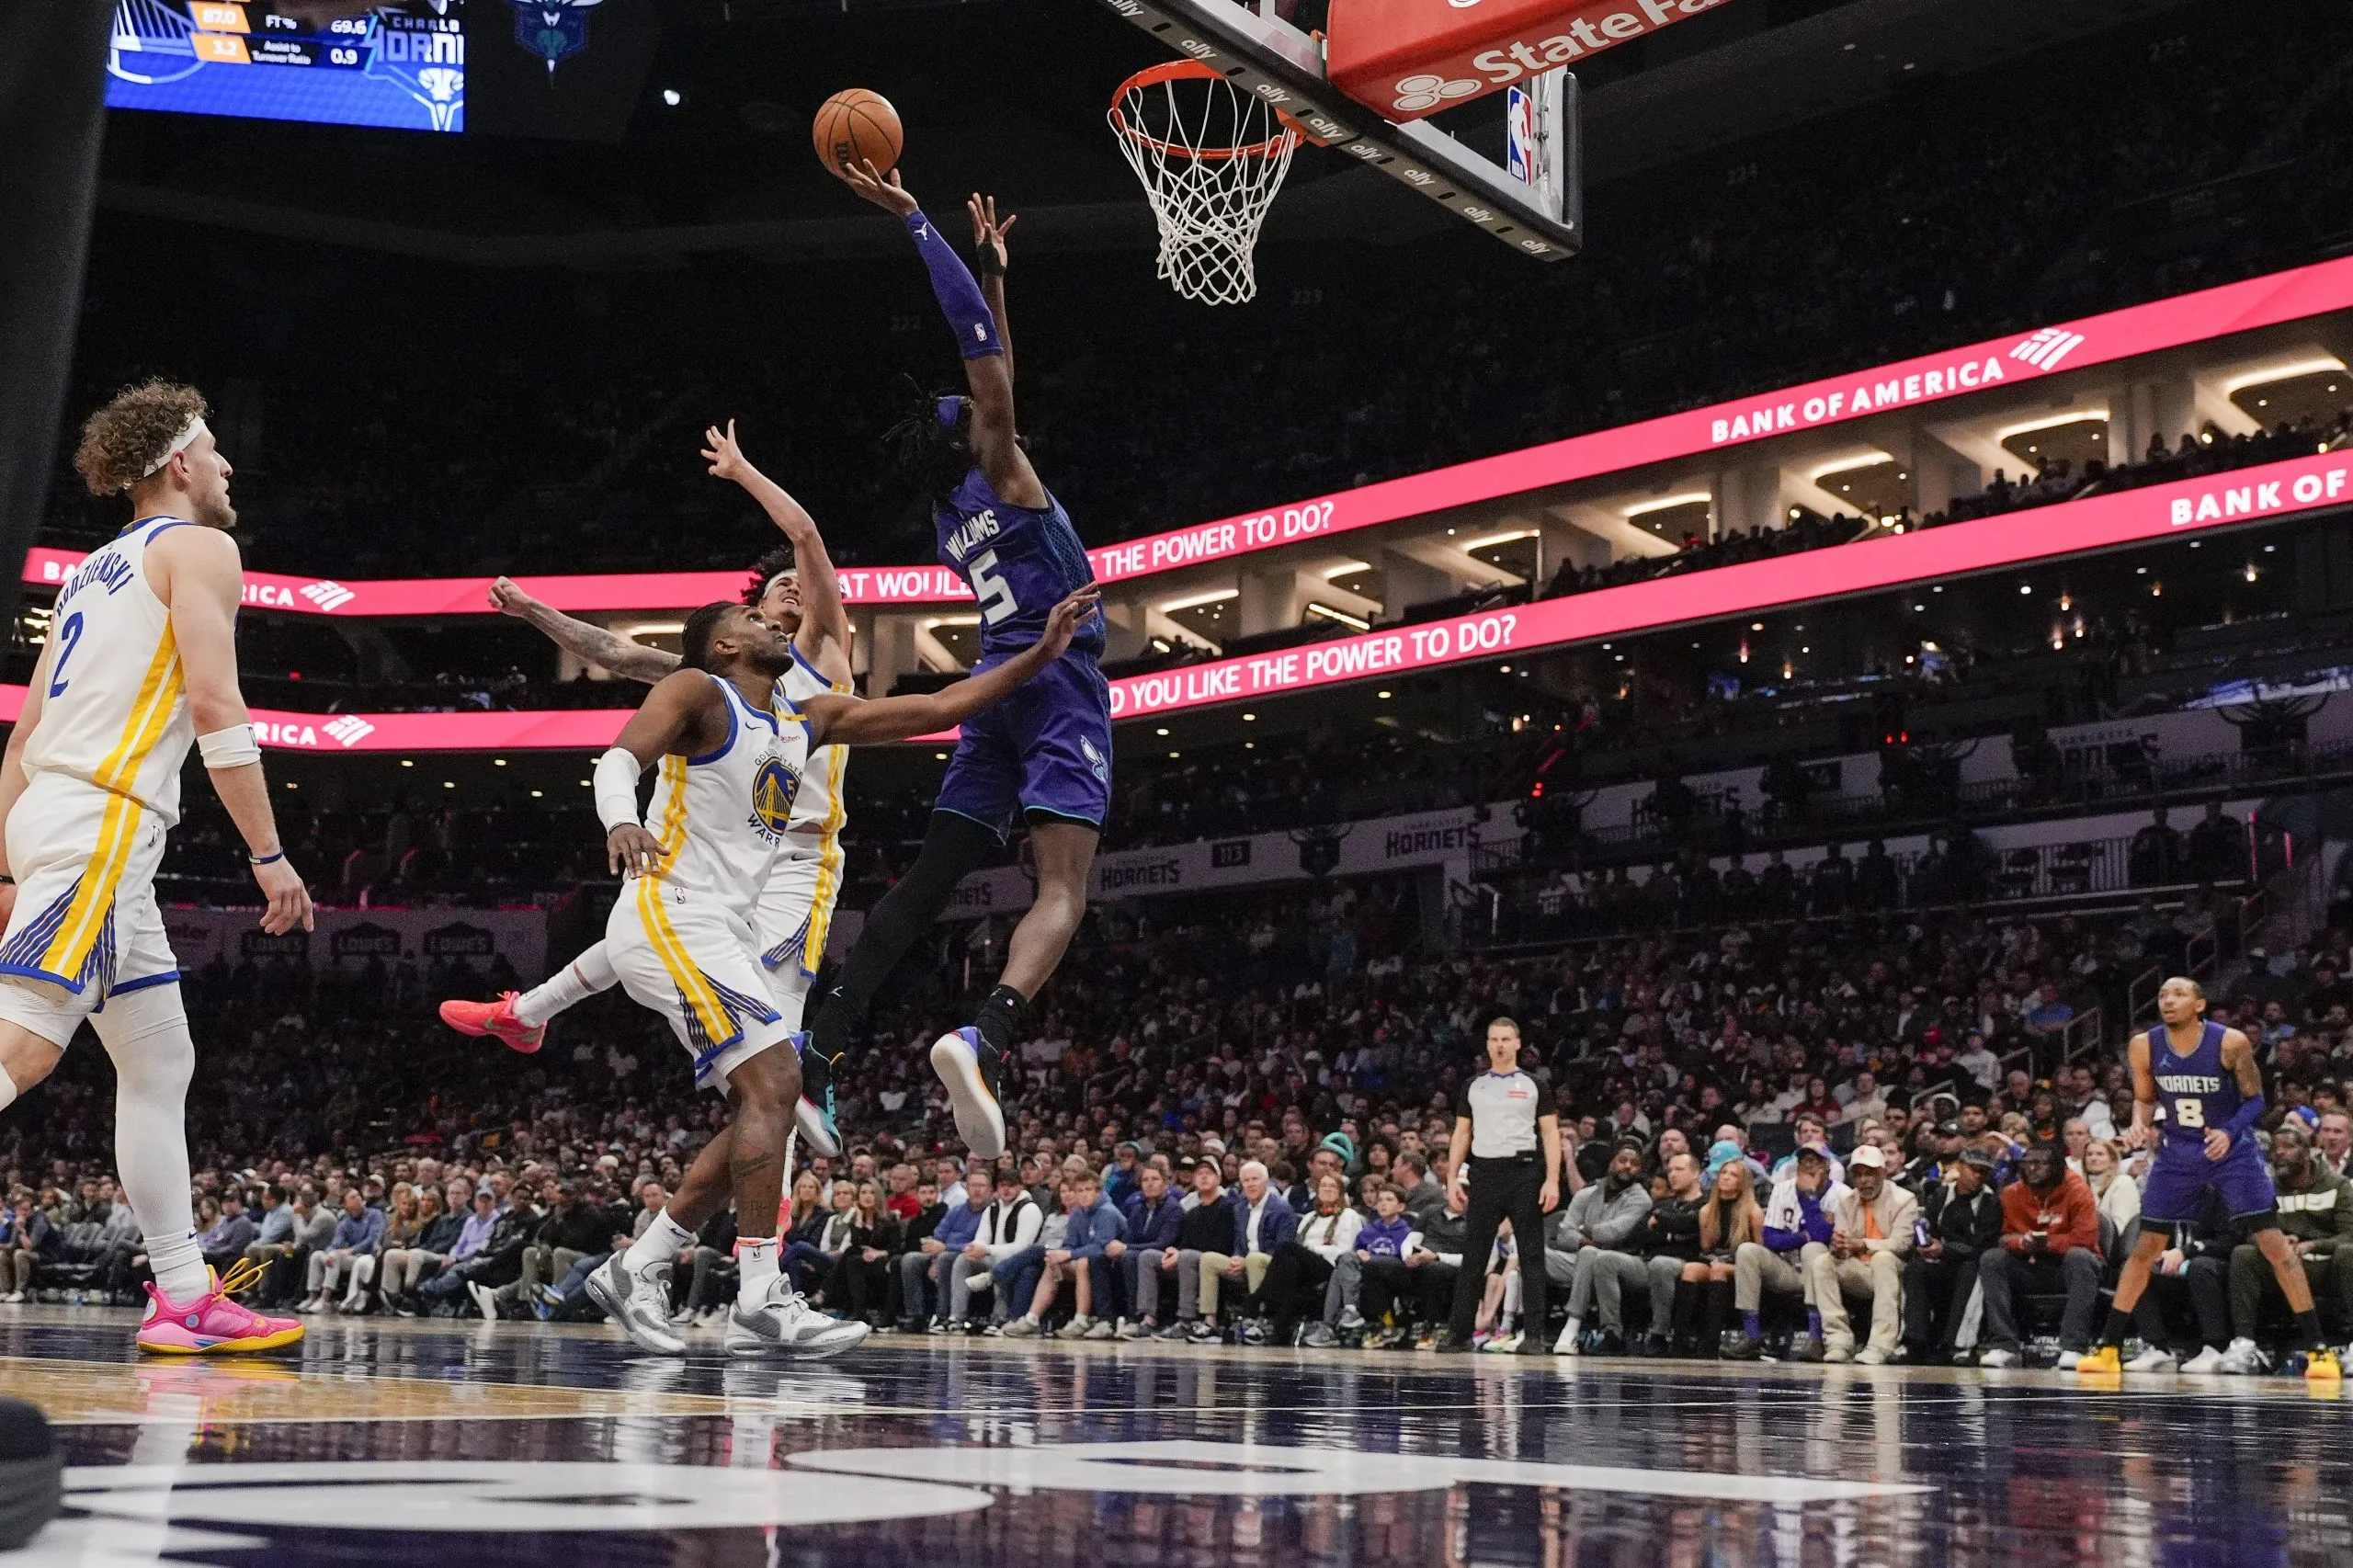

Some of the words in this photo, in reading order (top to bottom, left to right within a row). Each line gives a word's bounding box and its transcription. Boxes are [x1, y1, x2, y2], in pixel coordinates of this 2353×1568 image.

[1108, 0, 1144, 17] lly
[331, 20, 367, 35] 69.6
[392, 16, 460, 32] CHARLO
[1181, 40, 1217, 59] ally
[1472, 12, 1644, 84] State
[1636, 0, 1721, 26] Fa
[331, 49, 358, 64] 0.9
[1256, 85, 1290, 103] ally
[1310, 119, 1343, 138] ally
[1351, 145, 1381, 159] ally
[1404, 169, 1436, 186] ally
[1464, 207, 1494, 222] ally
[1521, 240, 1551, 254] ally
[1712, 404, 1794, 442] BANK
[1803, 393, 1843, 421] OF
[1852, 358, 2003, 412] AMERICA
[2172, 482, 2280, 525] BANK
[2293, 470, 2346, 502] OF
[945, 509, 1000, 562] WILLIAMS
[837, 574, 870, 598] AT
[1102, 545, 1144, 575] THE
[1154, 525, 1234, 566] POWER
[1243, 516, 1276, 544] TO
[1284, 502, 1333, 537] DO?
[43, 561, 77, 581] BA
[968, 549, 1019, 625] 5
[49, 611, 84, 699] 2
[1131, 676, 1180, 709] YOU
[1188, 665, 1240, 699] LIKE
[1248, 654, 1298, 687] THE
[1307, 637, 1402, 679] POWER
[1411, 628, 1449, 659] TO
[1460, 615, 1516, 653] DO?
[254, 722, 317, 745] RICA
[747, 813, 780, 848] WARR
[1385, 821, 1481, 859] HORNETS
[1100, 858, 1180, 892] HORNETS
[2175, 1098, 2204, 1128] 8
